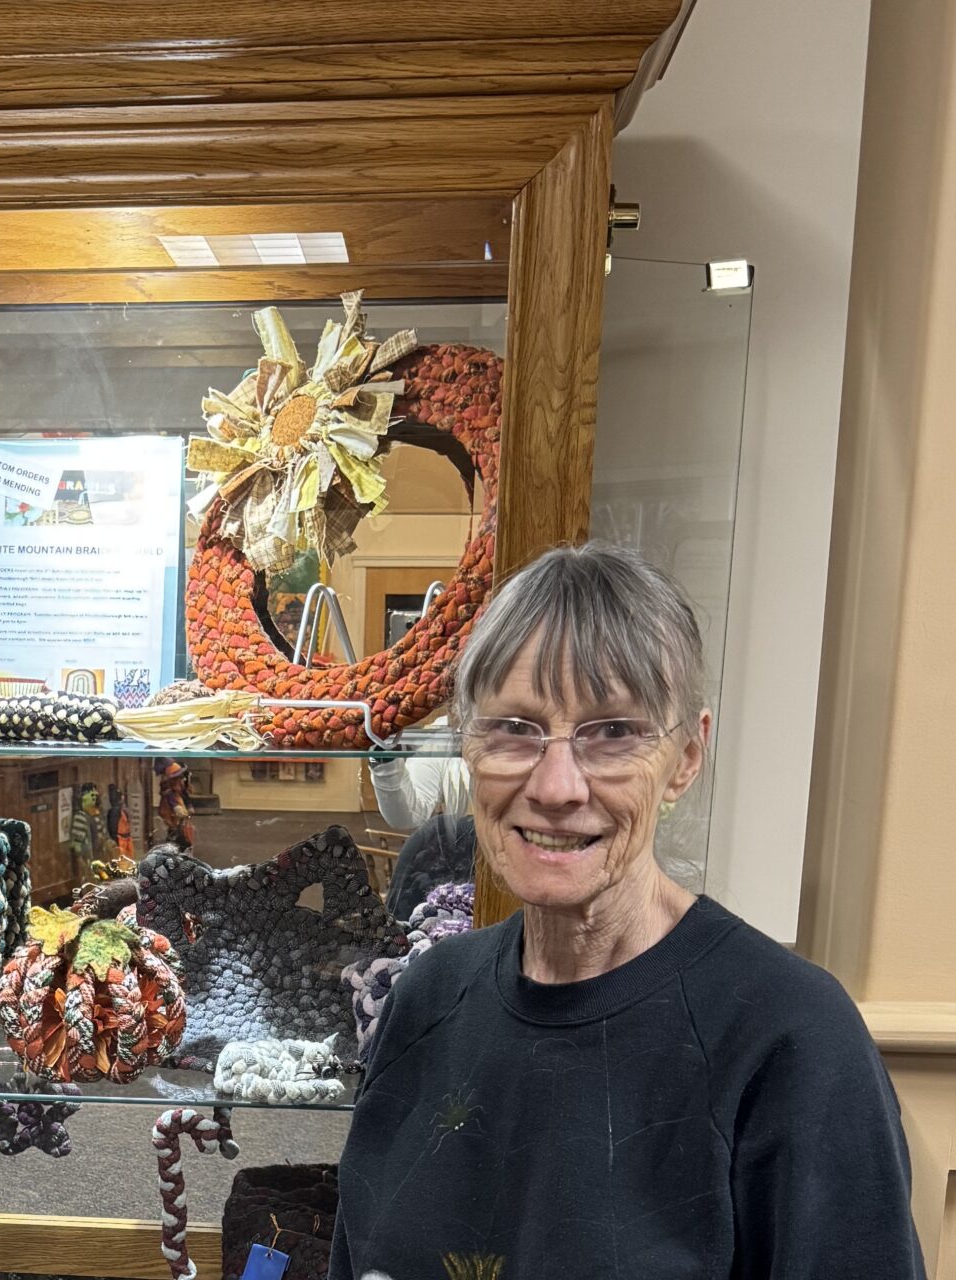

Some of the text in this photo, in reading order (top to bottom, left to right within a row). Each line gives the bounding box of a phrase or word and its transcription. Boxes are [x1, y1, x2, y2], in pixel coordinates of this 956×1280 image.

[16, 467, 50, 485] ORDERS
[3, 478, 41, 497] MENDING
[17, 545, 73, 555] MOUNTAIN
